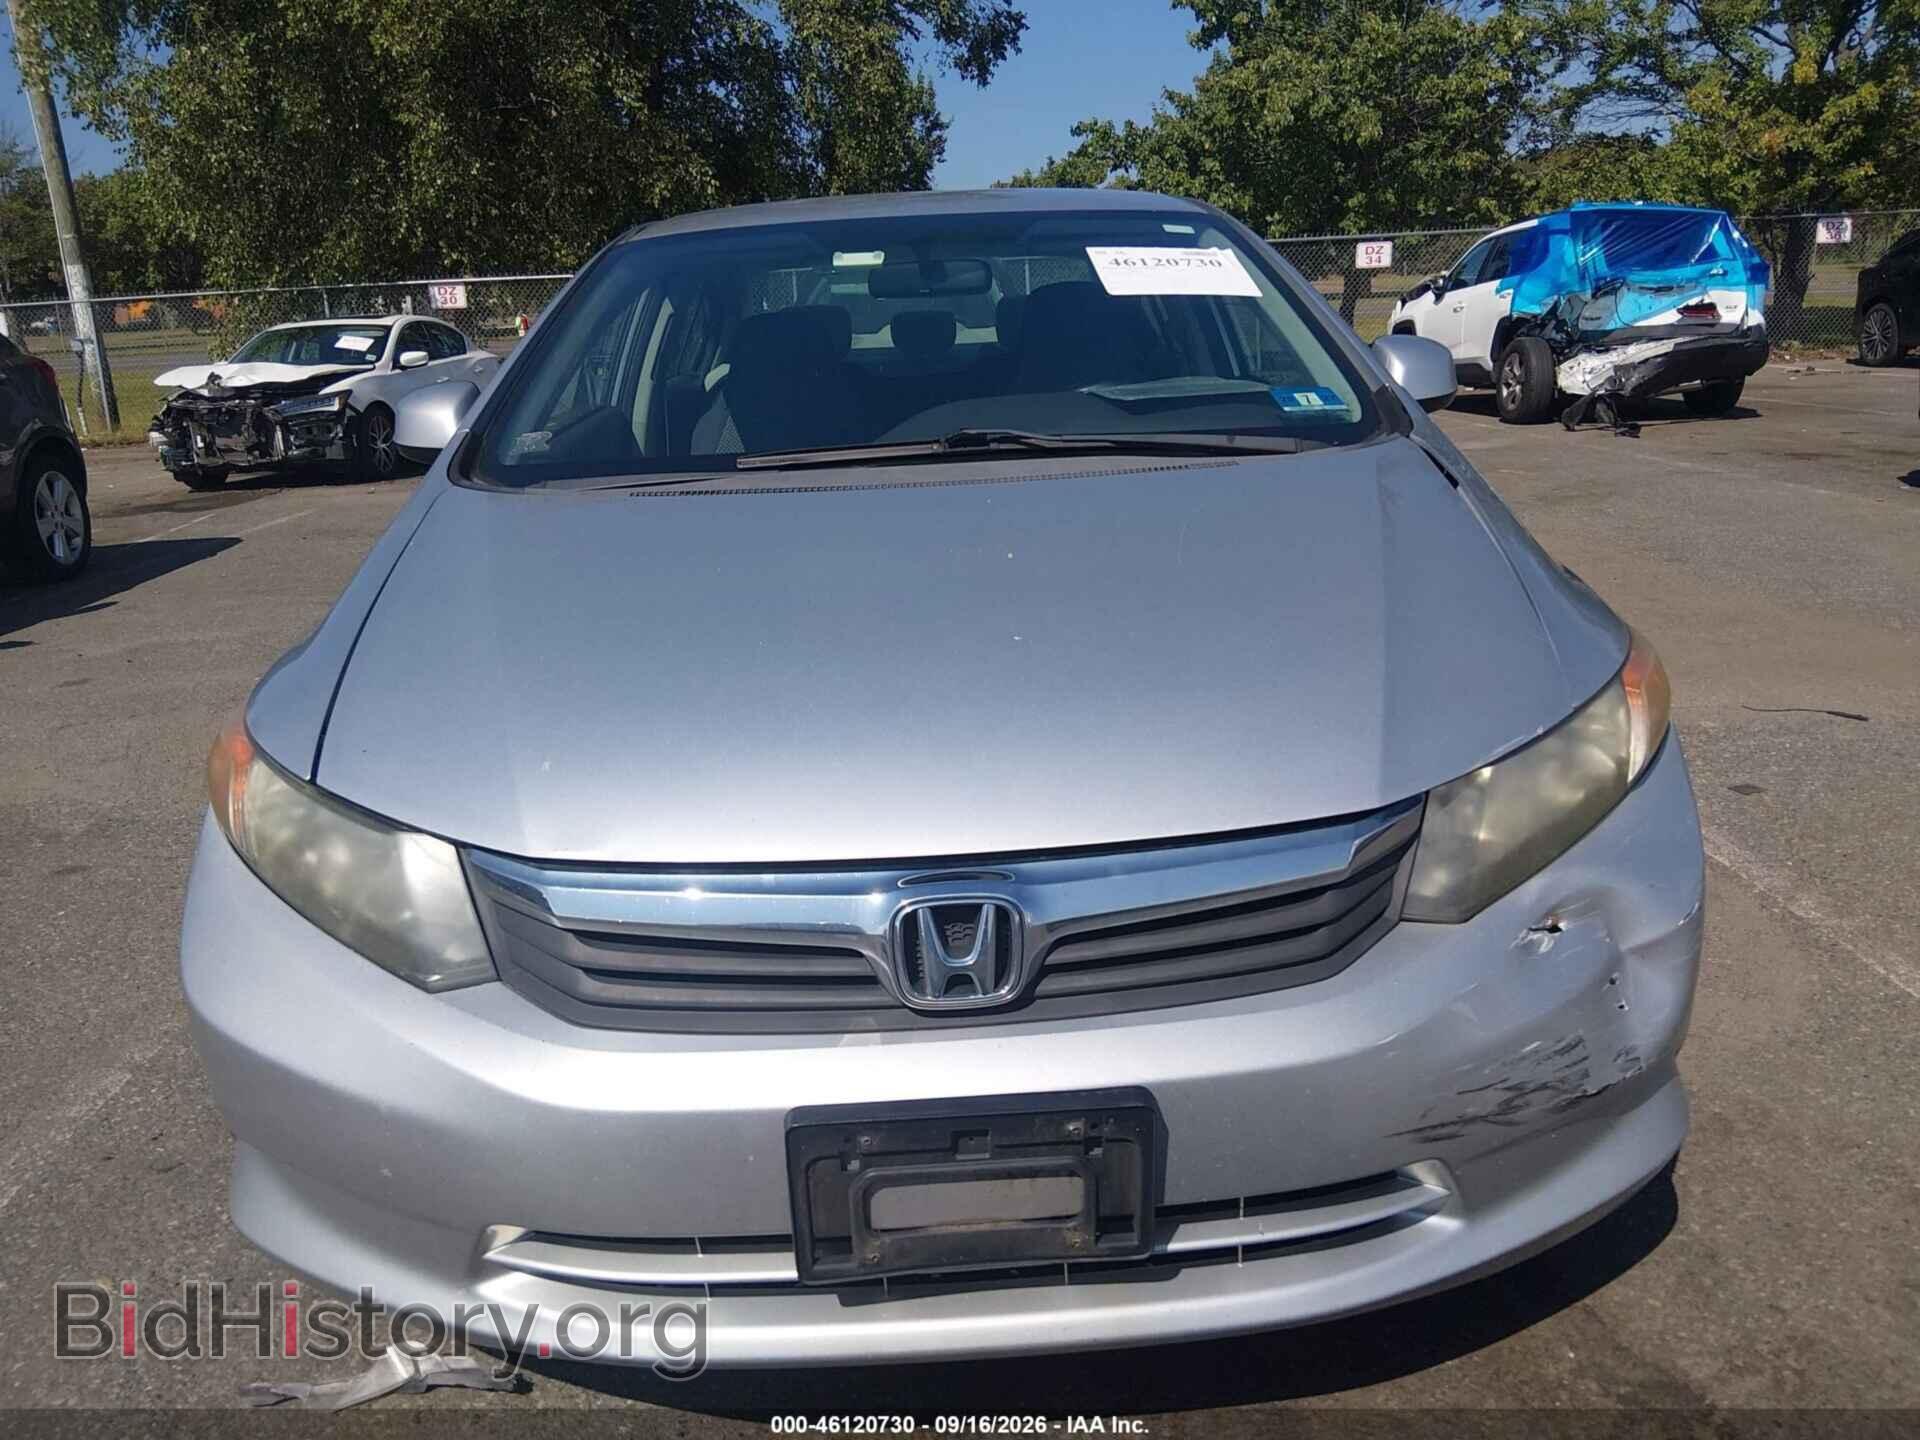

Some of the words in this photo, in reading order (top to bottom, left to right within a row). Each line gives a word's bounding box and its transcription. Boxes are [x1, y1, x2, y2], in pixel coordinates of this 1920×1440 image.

[1365, 246, 1384, 255] DZ
[1108, 257, 1223, 269] 46120730
[1365, 255, 1382, 265] 34
[438, 286, 457, 295] DZ
[440, 295, 457, 305] 30
